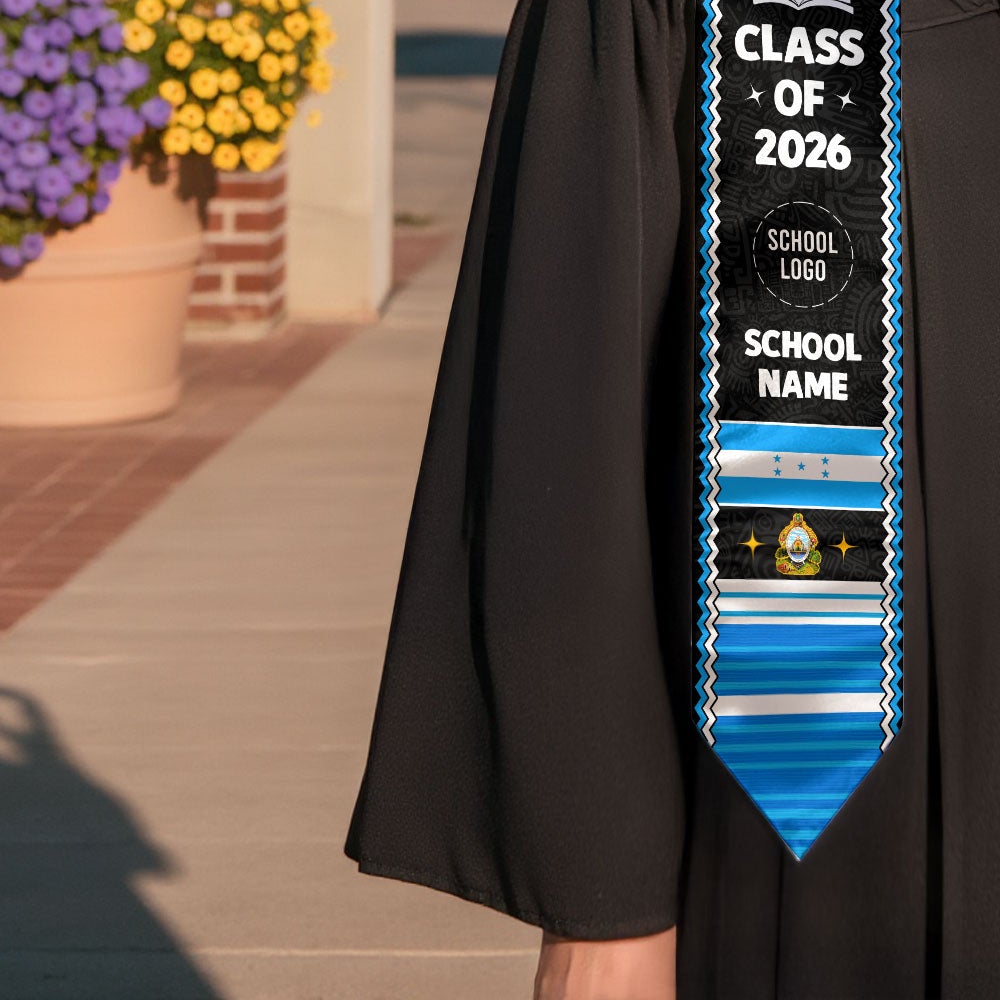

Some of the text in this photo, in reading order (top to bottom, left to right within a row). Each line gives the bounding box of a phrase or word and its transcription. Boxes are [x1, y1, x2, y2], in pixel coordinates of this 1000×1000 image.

[735, 23, 865, 66] CLASS
[773, 79, 825, 117] OF
[755, 128, 852, 170] 2026
[768, 228, 838, 254] SCHOOL
[780, 258, 826, 282] LOGO
[744, 328, 862, 362] SCHOOL
[758, 368, 848, 401] NAME
